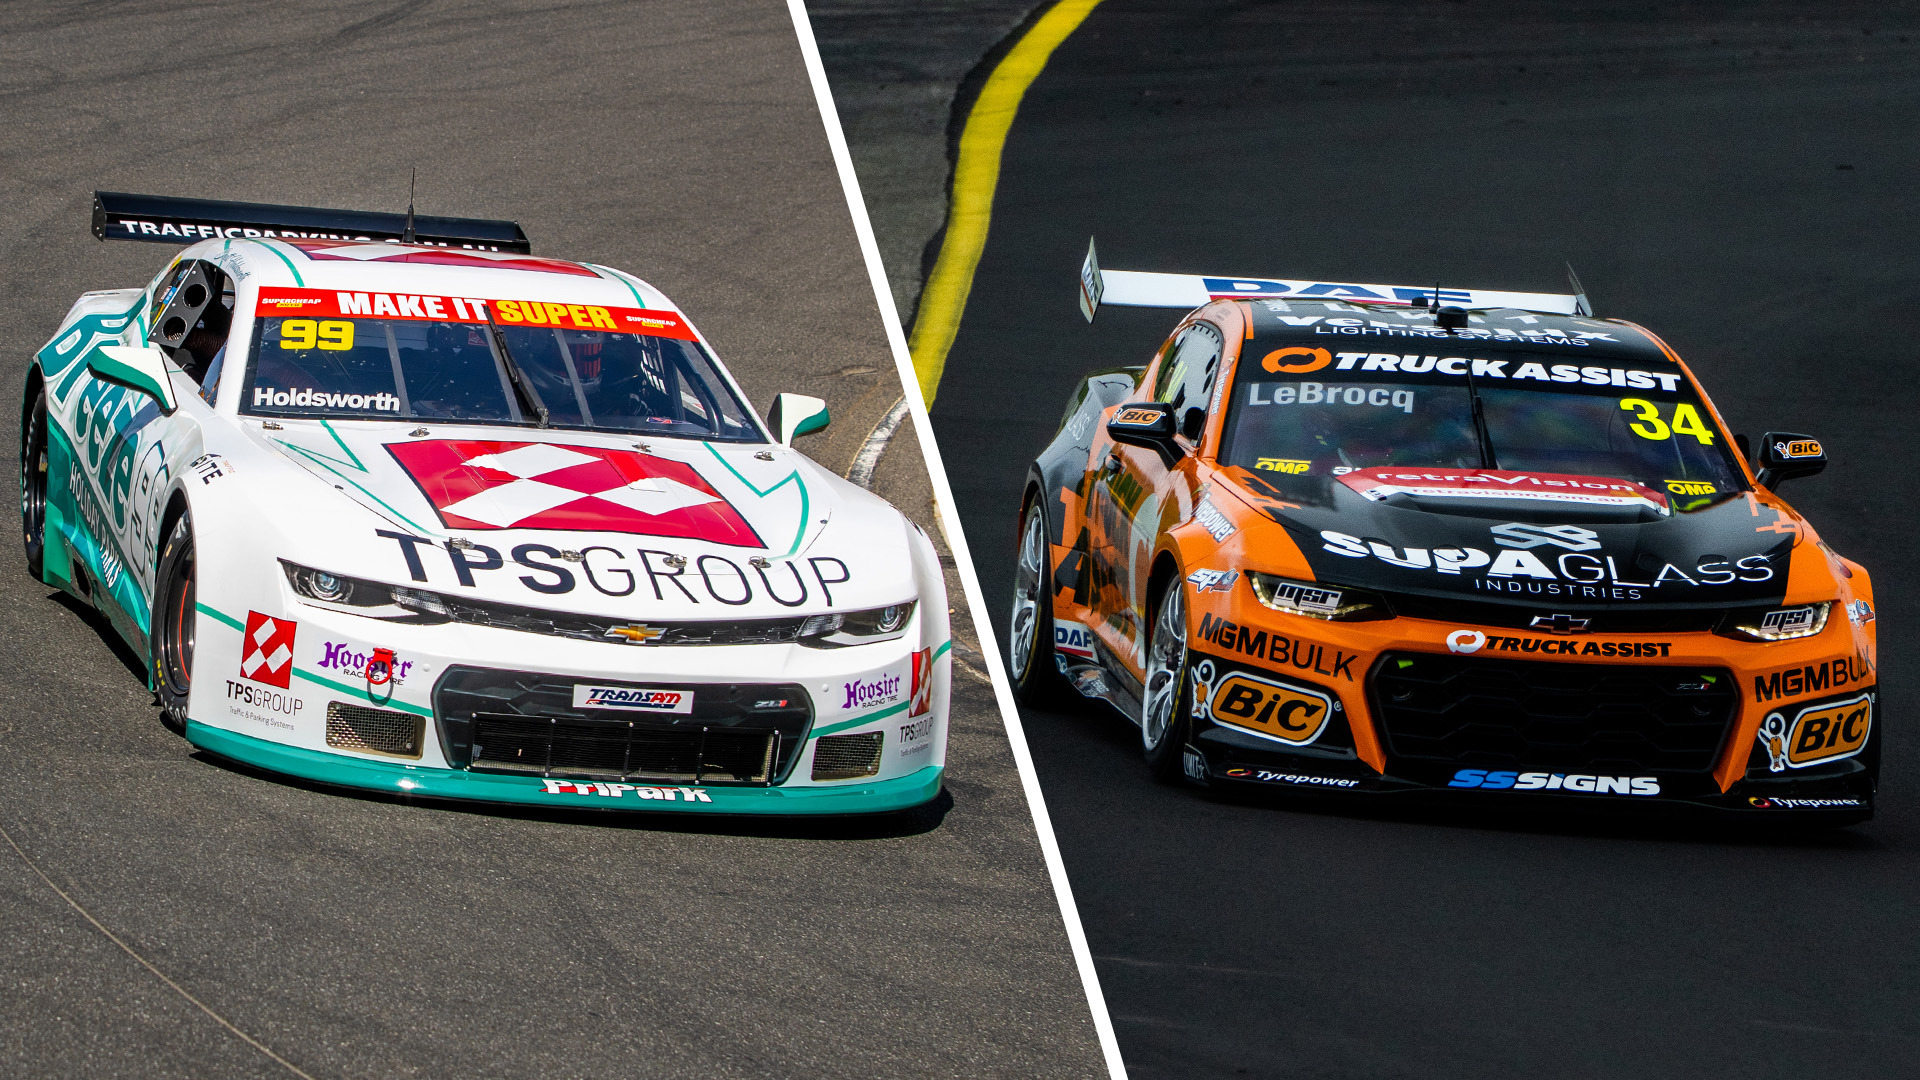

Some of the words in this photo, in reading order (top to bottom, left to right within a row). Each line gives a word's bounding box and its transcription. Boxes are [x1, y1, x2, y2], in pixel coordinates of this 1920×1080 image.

[261, 297, 322, 305] SUPERCHEAP
[1202, 278, 1472, 304] DAF
[336, 292, 448, 320] MAKE
[450, 296, 488, 321] IT
[496, 300, 618, 330] SUPER
[280, 319, 355, 351] 99
[1315, 326, 1444, 339] LIGHTING
[1457, 330, 1590, 347] SYSTEMS
[1334, 351, 1508, 379] TRUCK
[1511, 361, 1681, 392] ASSIST
[253, 387, 401, 411] Holdsworth
[1249, 382, 1415, 414] LeBrocq
[1619, 397, 1714, 446] 34
[1255, 458, 1311, 476] OMP
[1666, 481, 1718, 497] OMP
[375, 529, 851, 608] TPSGROUP
[1475, 578, 1641, 600] INDUSTRIES
[1055, 627, 1092, 648] DAF
[1196, 612, 1359, 682] MGMBULK
[1485, 636, 1579, 656] TRUCK
[1585, 640, 1672, 658] ASSIST
[1754, 645, 1876, 703] MGMBULK
[226, 680, 303, 716] TPSGROUP
[841, 672, 901, 710] Hoosier
[862, 697, 886, 709] RACING
[886, 694, 898, 703] TIRE
[229, 705, 245, 718] Traffic
[250, 712, 270, 726] Parking
[270, 717, 295, 731] Systems
[540, 779, 713, 803] PriPark
[1256, 770, 1360, 788] Tyrepower
[1768, 797, 1860, 808] Tyrepower
